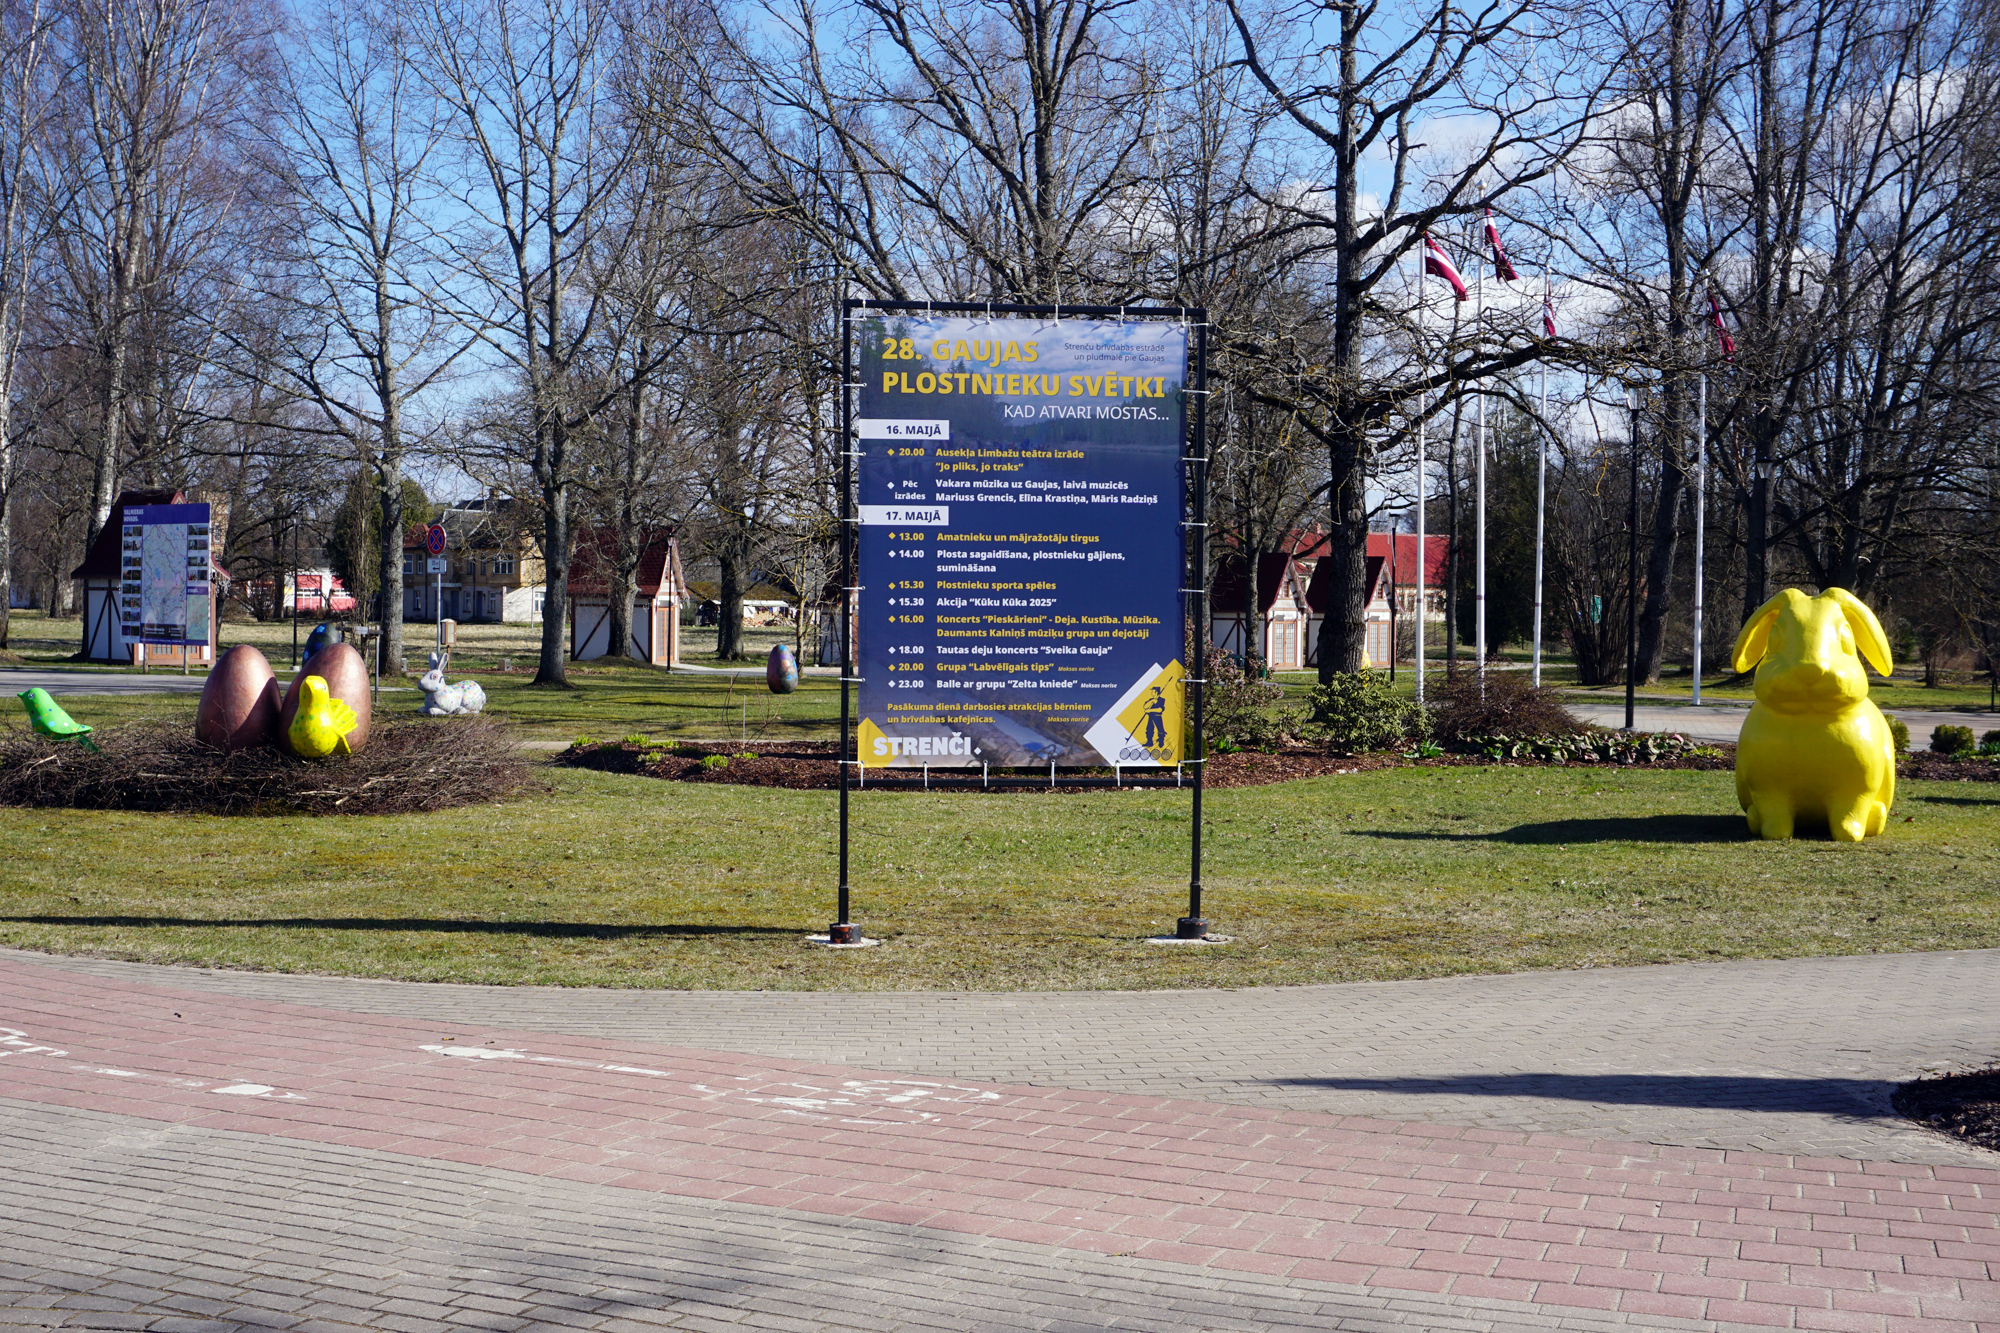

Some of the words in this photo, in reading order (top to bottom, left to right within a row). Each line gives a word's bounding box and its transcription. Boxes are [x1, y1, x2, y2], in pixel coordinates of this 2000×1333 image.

[1064, 342, 1094, 351] Strenču
[1096, 343, 1134, 351] brīvdabas
[1136, 344, 1165, 352] estrādē
[882, 338, 923, 360] 28.
[931, 339, 1039, 368] GAUJAS
[1086, 353, 1122, 362] pludmalē
[1125, 354, 1136, 363] pie
[1138, 354, 1165, 363] Gaujas
[882, 371, 1060, 396] PLOSTNIEKU
[1068, 371, 1166, 398] SVĒTKI
[1004, 404, 1035, 418] KAD
[1039, 406, 1092, 419] ATVARI
[1096, 407, 1170, 421] MOSTAS...
[886, 425, 902, 435] 16.
[905, 424, 942, 437] MAIJĀ
[899, 448, 925, 456] 20.00
[935, 448, 975, 459] Ausekļa
[977, 448, 1019, 458] Limbažu
[1021, 450, 1052, 458] teātra
[1054, 450, 1085, 458] izrāde
[952, 463, 979, 473] pliks,
[980, 463, 991, 473] jo
[902, 480, 918, 488] Pēc
[935, 479, 970, 488] Vakara
[972, 480, 1009, 488] mūzika
[1024, 480, 1061, 491] Gaujas,
[1063, 480, 1087, 490] laivā
[1089, 481, 1129, 490] muzicēs
[894, 492, 926, 500] izrādes
[935, 493, 975, 502] Mariuss
[977, 493, 1017, 504] Grencis,
[1019, 494, 1043, 503] Elīna
[1045, 494, 1089, 505] Krastiņa,
[1091, 495, 1119, 504] Māris
[1120, 495, 1158, 505] Radziņš
[886, 511, 902, 521] 17.
[905, 510, 941, 523] MAIJĀ
[899, 532, 924, 541] 13.00
[936, 533, 992, 541] Amatnieku
[1009, 533, 1068, 544] mājražotāju
[1070, 534, 1100, 545] tirgus
[899, 550, 924, 558] 14.00
[936, 550, 968, 559] Plosta
[969, 550, 1031, 561] sagaidīšana,
[1033, 551, 1085, 561] plostnieku
[1087, 551, 1126, 562] gājiens,
[936, 563, 997, 572] sumināšana
[899, 581, 924, 589] 15.30
[936, 581, 989, 590] Plostnieku
[991, 582, 1024, 591] sporta
[1025, 581, 1057, 591] spēles
[899, 598, 924, 606] 15.30
[936, 598, 968, 608] Akcija
[1002, 598, 1027, 607] Kūka
[899, 615, 924, 623] 16.00
[936, 615, 981, 624] Koncerts
[1054, 616, 1079, 626] Deja.
[1081, 615, 1121, 624] Kustība.
[1123, 615, 1161, 625] Mūzika.
[936, 629, 987, 638] Daumants
[989, 629, 1026, 640] Kalniņš
[1027, 629, 1064, 640] mūziķu
[1066, 632, 1095, 640] grupa
[1112, 629, 1149, 640] dejotāji
[899, 646, 924, 654] 18.00
[936, 646, 970, 655] Tautas
[971, 646, 994, 656] deju
[995, 646, 1039, 655] koncerts
[898, 663, 924, 671] 20.00
[936, 663, 967, 673] Grupa
[898, 680, 924, 688] 23.00
[936, 680, 961, 688] Balle
[975, 682, 1006, 690] grupu
[887, 703, 934, 711] Pasākuma
[935, 703, 961, 711] dienā
[963, 703, 1006, 711] darbosies
[1007, 703, 1052, 712] atrakcijas
[1054, 703, 1092, 711] bērniem
[901, 715, 946, 723] brīvdabas
[947, 715, 996, 725] kafejnīcas.
